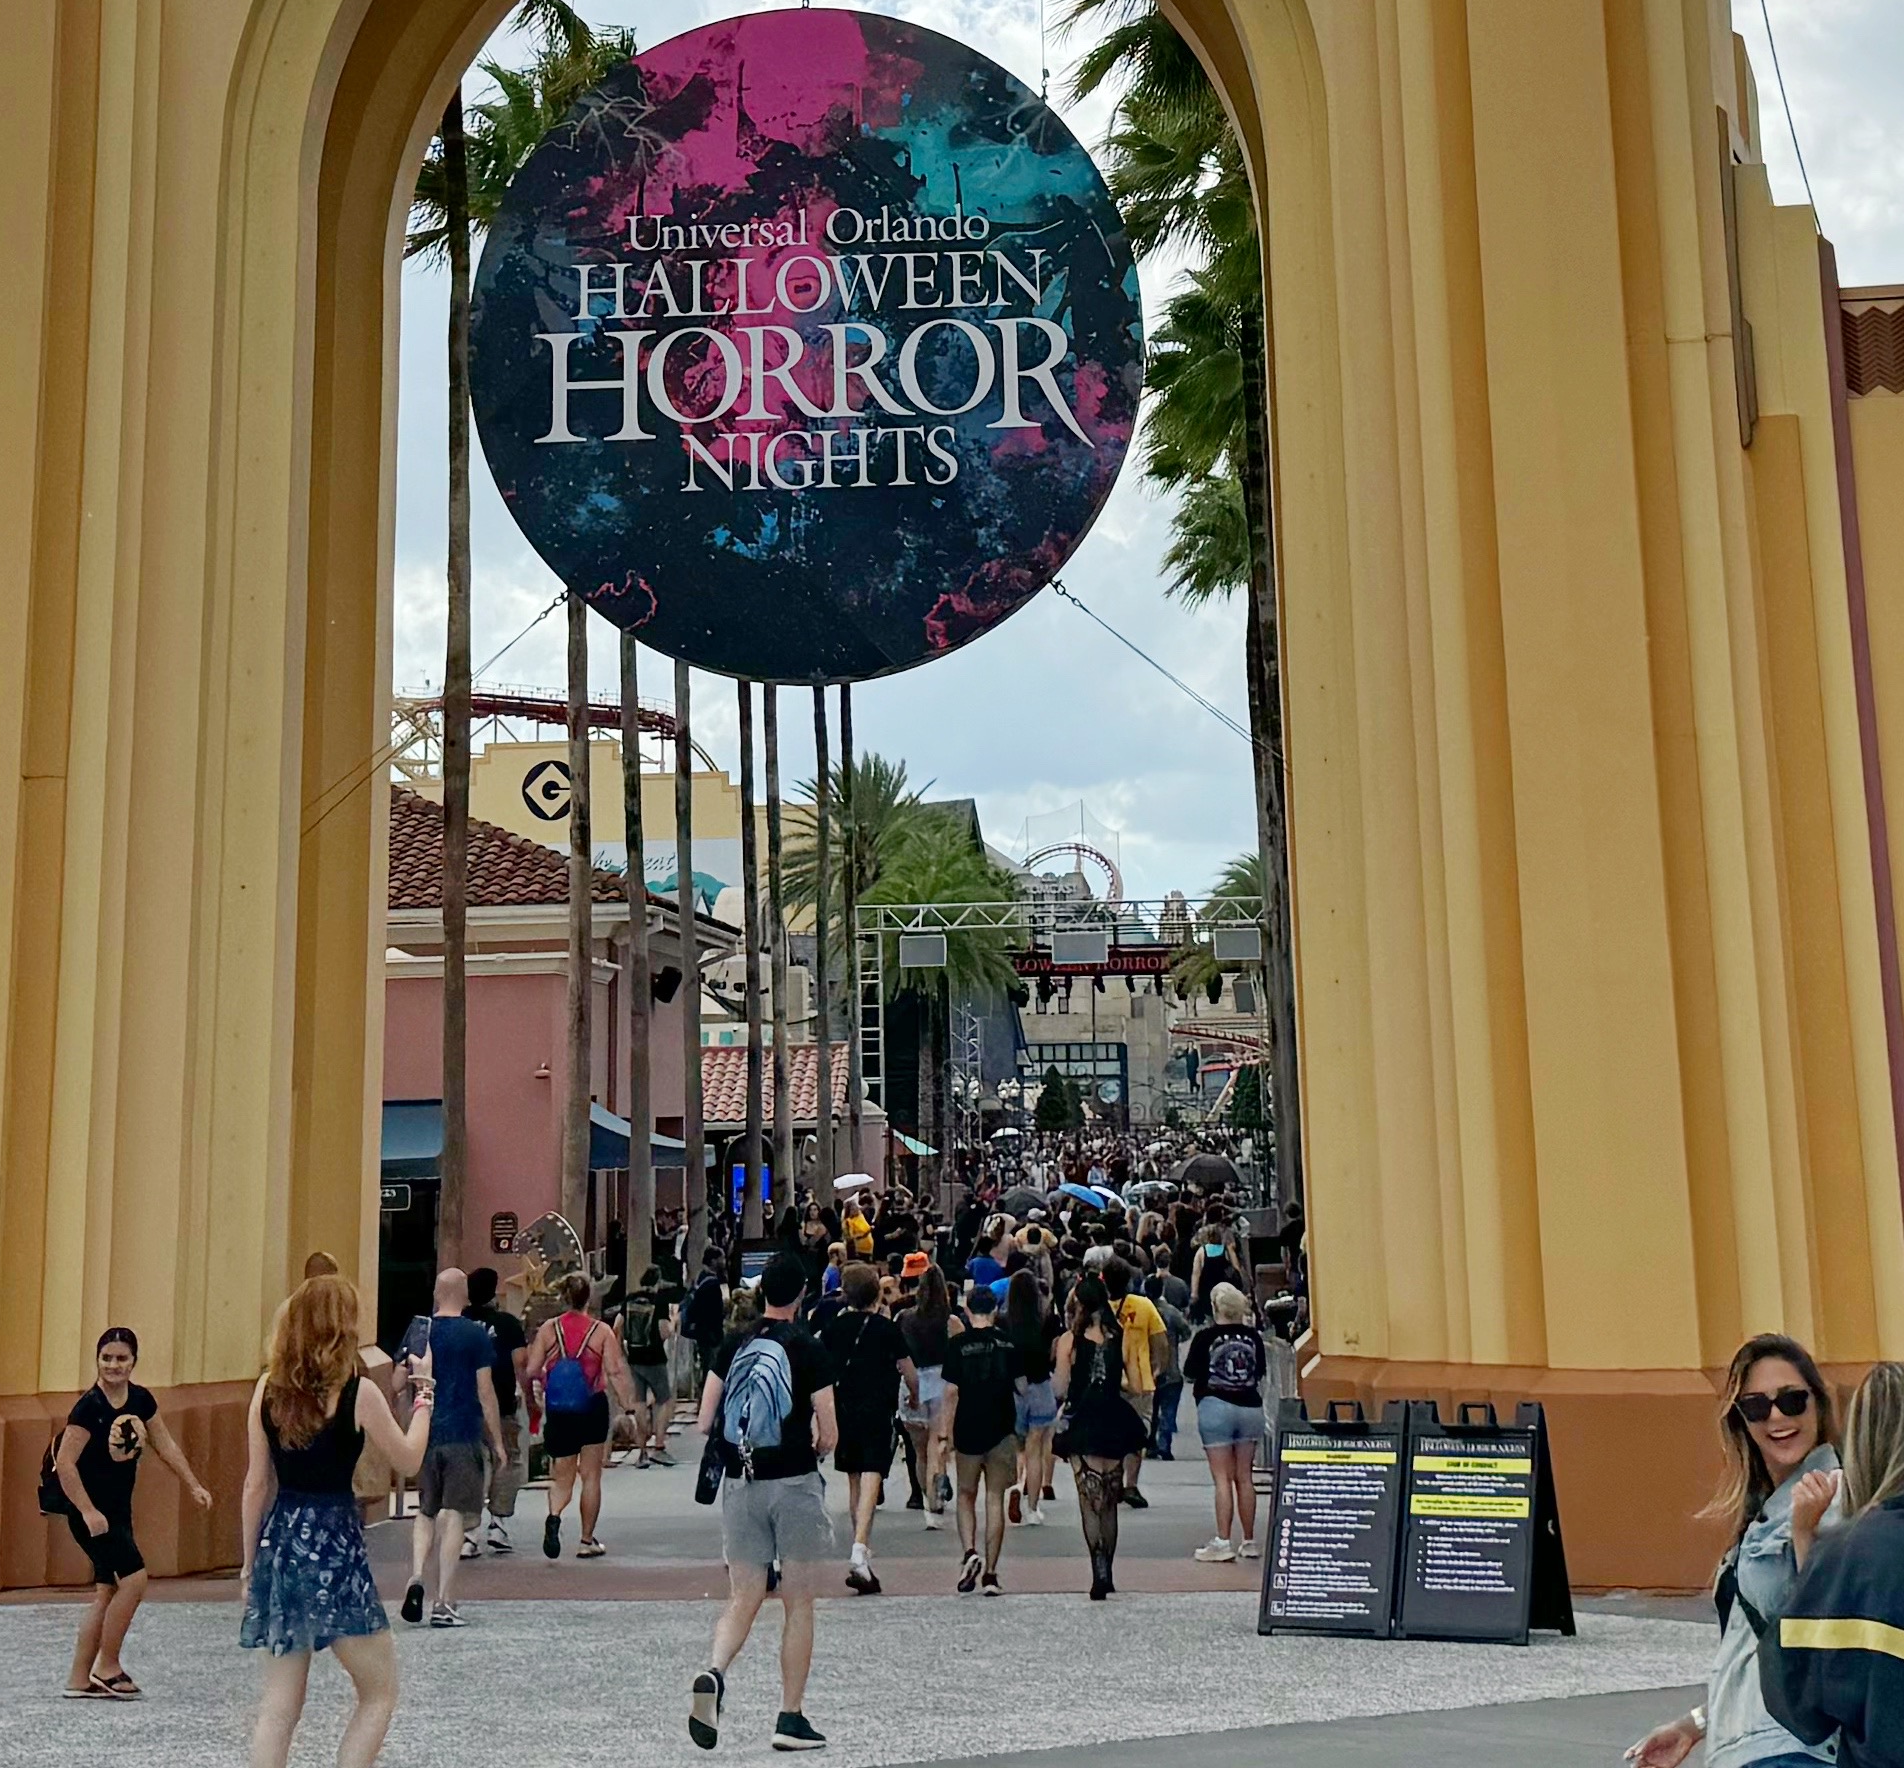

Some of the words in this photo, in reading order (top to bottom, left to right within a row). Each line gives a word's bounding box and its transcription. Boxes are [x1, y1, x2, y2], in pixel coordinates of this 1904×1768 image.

[625, 208, 807, 252] Universal
[826, 203, 989, 245] Orlando
[571, 248, 1049, 321] HALLOWEEN
[534, 317, 1095, 449] HORROR
[680, 425, 959, 492] NIGHTS
